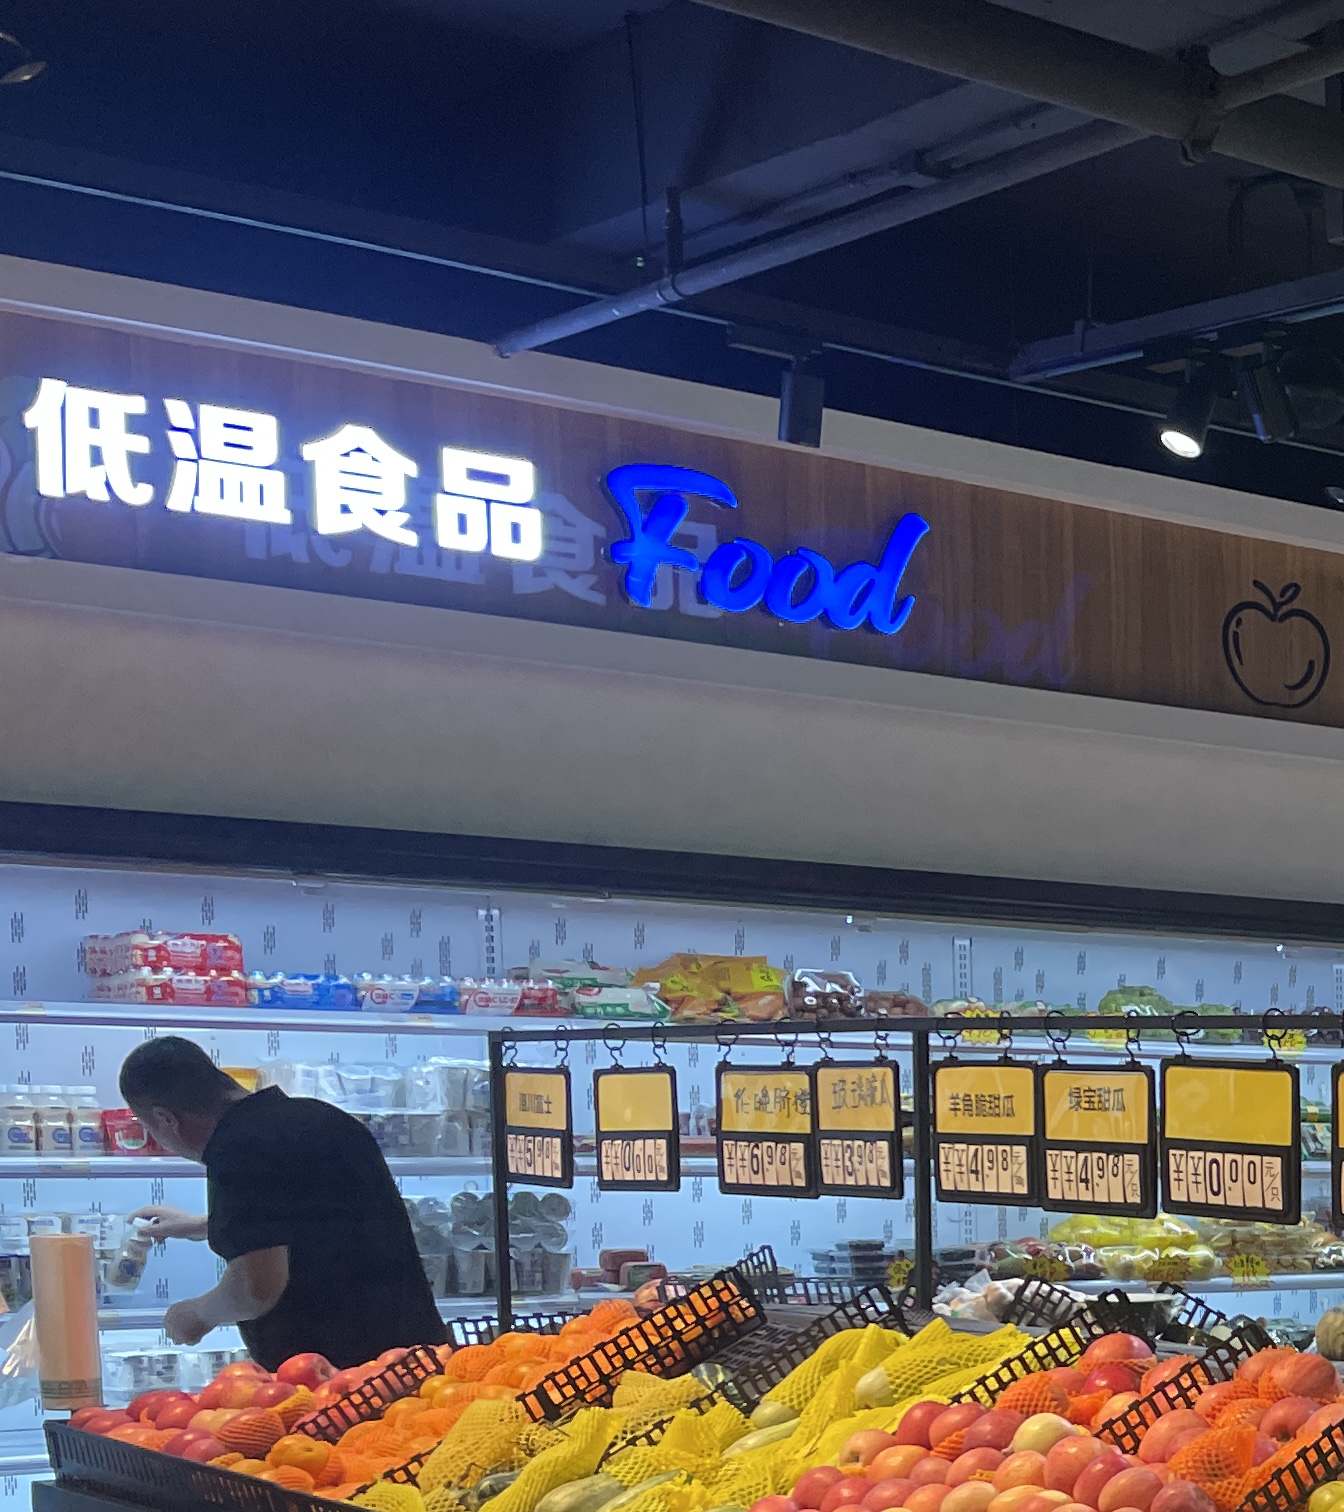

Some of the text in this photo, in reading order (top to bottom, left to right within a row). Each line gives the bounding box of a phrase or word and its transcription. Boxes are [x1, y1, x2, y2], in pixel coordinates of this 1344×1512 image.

[24, 378, 544, 562] 低温食品
[604, 461, 931, 635] Food
[1067, 1086, 1127, 1112] 绿宝甜瓜
